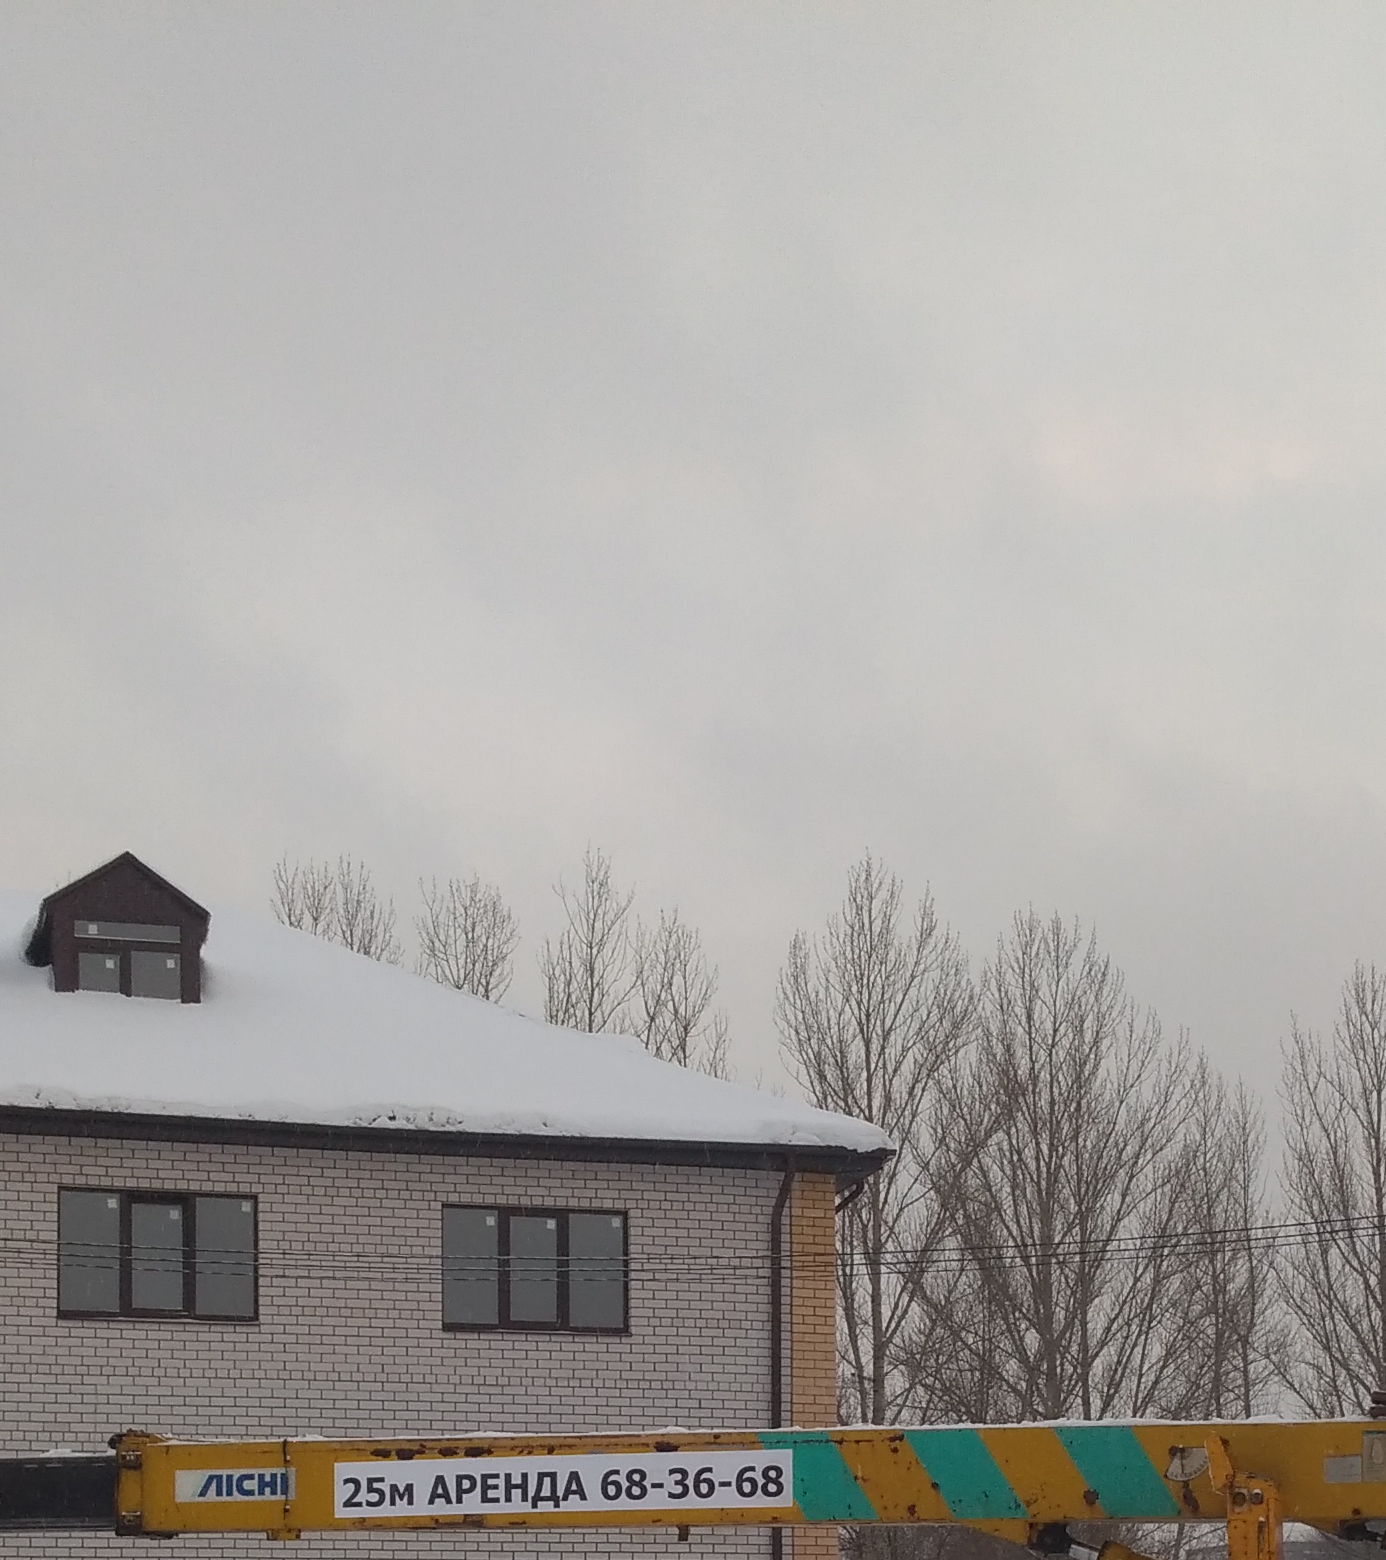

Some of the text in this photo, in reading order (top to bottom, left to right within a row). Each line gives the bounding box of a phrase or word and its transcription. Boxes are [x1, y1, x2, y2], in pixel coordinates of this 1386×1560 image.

[192, 1472, 288, 1498] AICHI
[342, 1465, 784, 1509] 25м АРЕНДА 68-36-68
